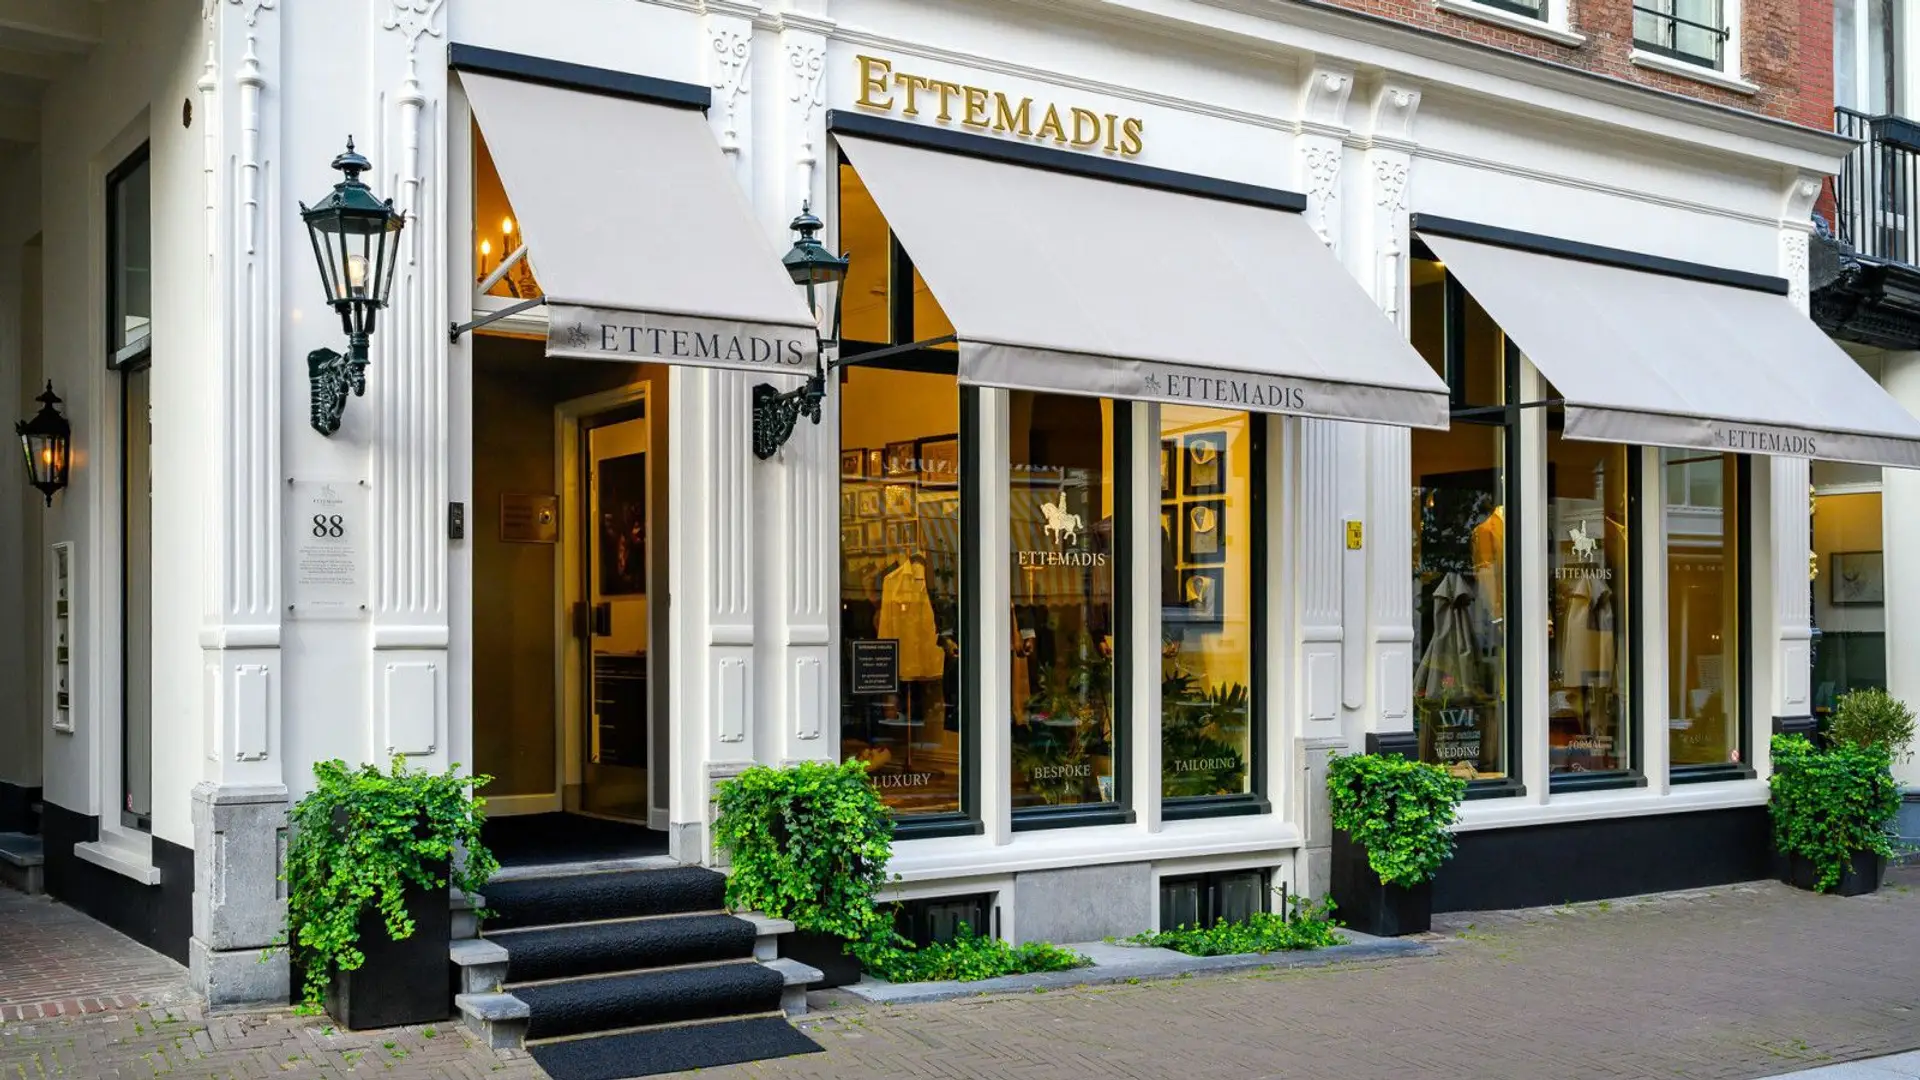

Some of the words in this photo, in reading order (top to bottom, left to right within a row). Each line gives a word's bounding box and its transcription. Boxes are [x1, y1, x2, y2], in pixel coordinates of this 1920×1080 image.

[855, 54, 1144, 155] ETTEMADIS
[600, 324, 804, 365] ETTEMADIS
[1167, 374, 1305, 409] ETTEMADIS
[1728, 429, 1816, 455] ETTEMADIS
[312, 513, 344, 538] 88
[1018, 550, 1106, 567] ETTEMADIS
[1555, 567, 1612, 580] ETTEMADIS
[1436, 745, 1480, 760] WEDDING
[1034, 764, 1092, 779] BESPOKE
[1174, 757, 1235, 772] TAILORING
[873, 772, 931, 788] LUXURY
